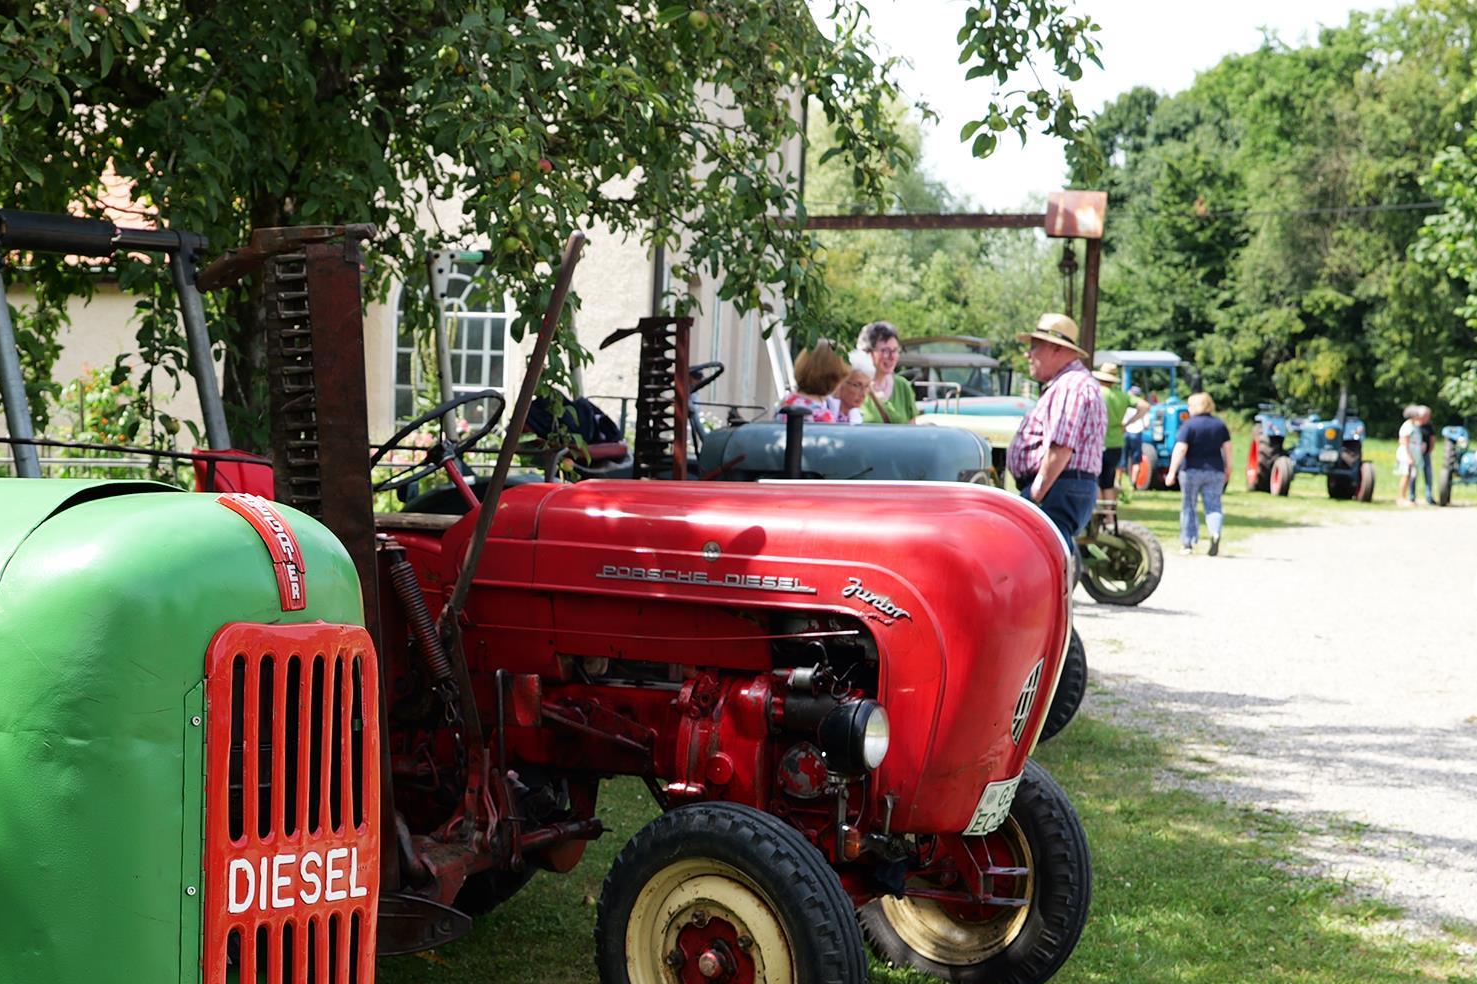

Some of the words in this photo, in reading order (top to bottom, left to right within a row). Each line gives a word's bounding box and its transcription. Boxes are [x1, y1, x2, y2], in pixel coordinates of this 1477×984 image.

[602, 565, 708, 583] PORSCHE
[724, 574, 811, 592] DIESEL
[841, 576, 912, 620] Junior
[228, 847, 368, 914] DIESEL
